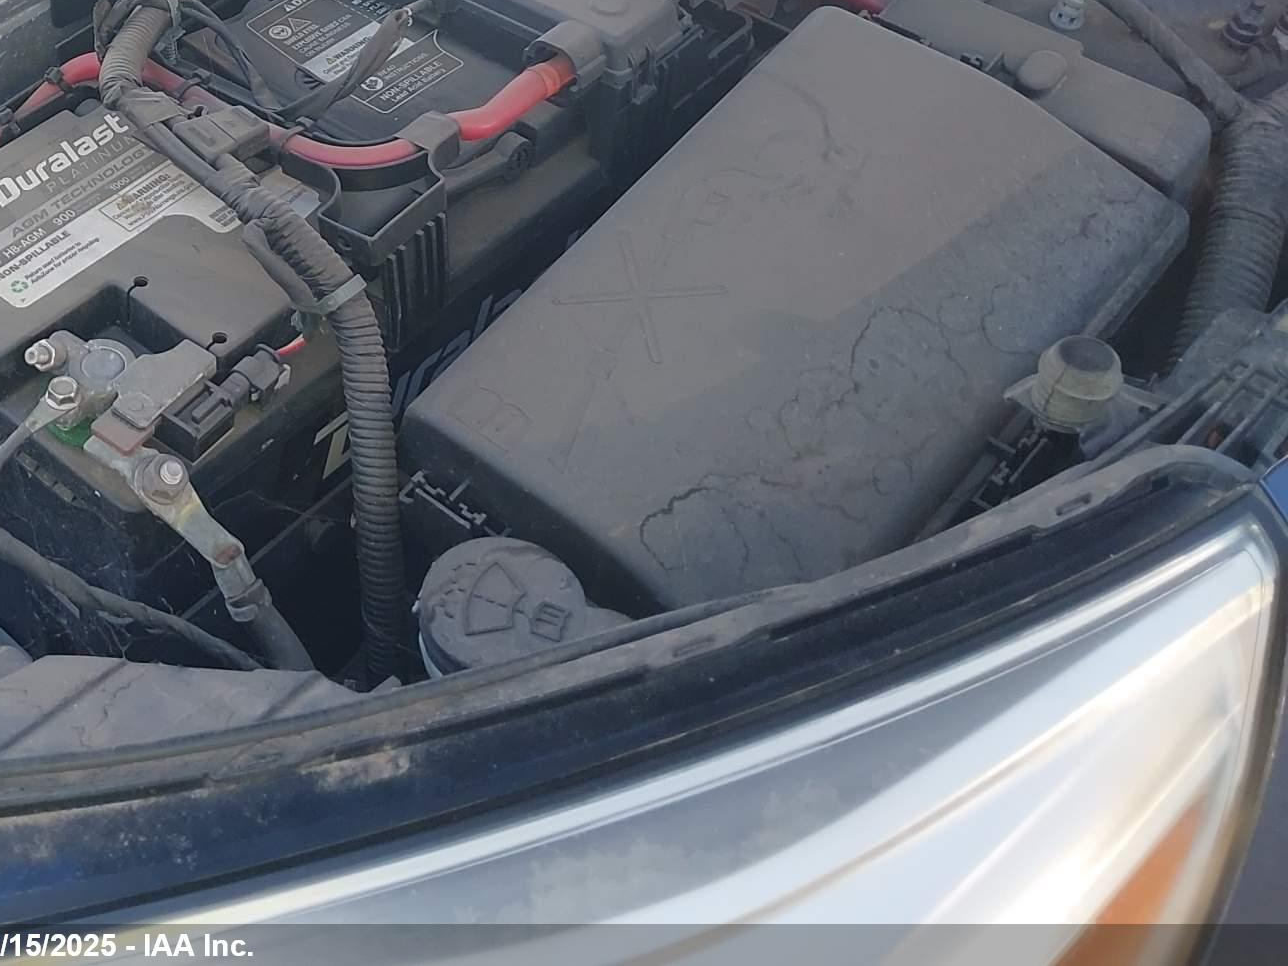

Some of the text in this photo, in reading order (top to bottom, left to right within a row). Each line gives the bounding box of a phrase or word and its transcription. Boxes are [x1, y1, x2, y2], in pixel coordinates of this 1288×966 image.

[380, 59, 442, 101] NON-SPILLABLE
[12, 208, 49, 238] AGM
[53, 209, 76, 226] 900
